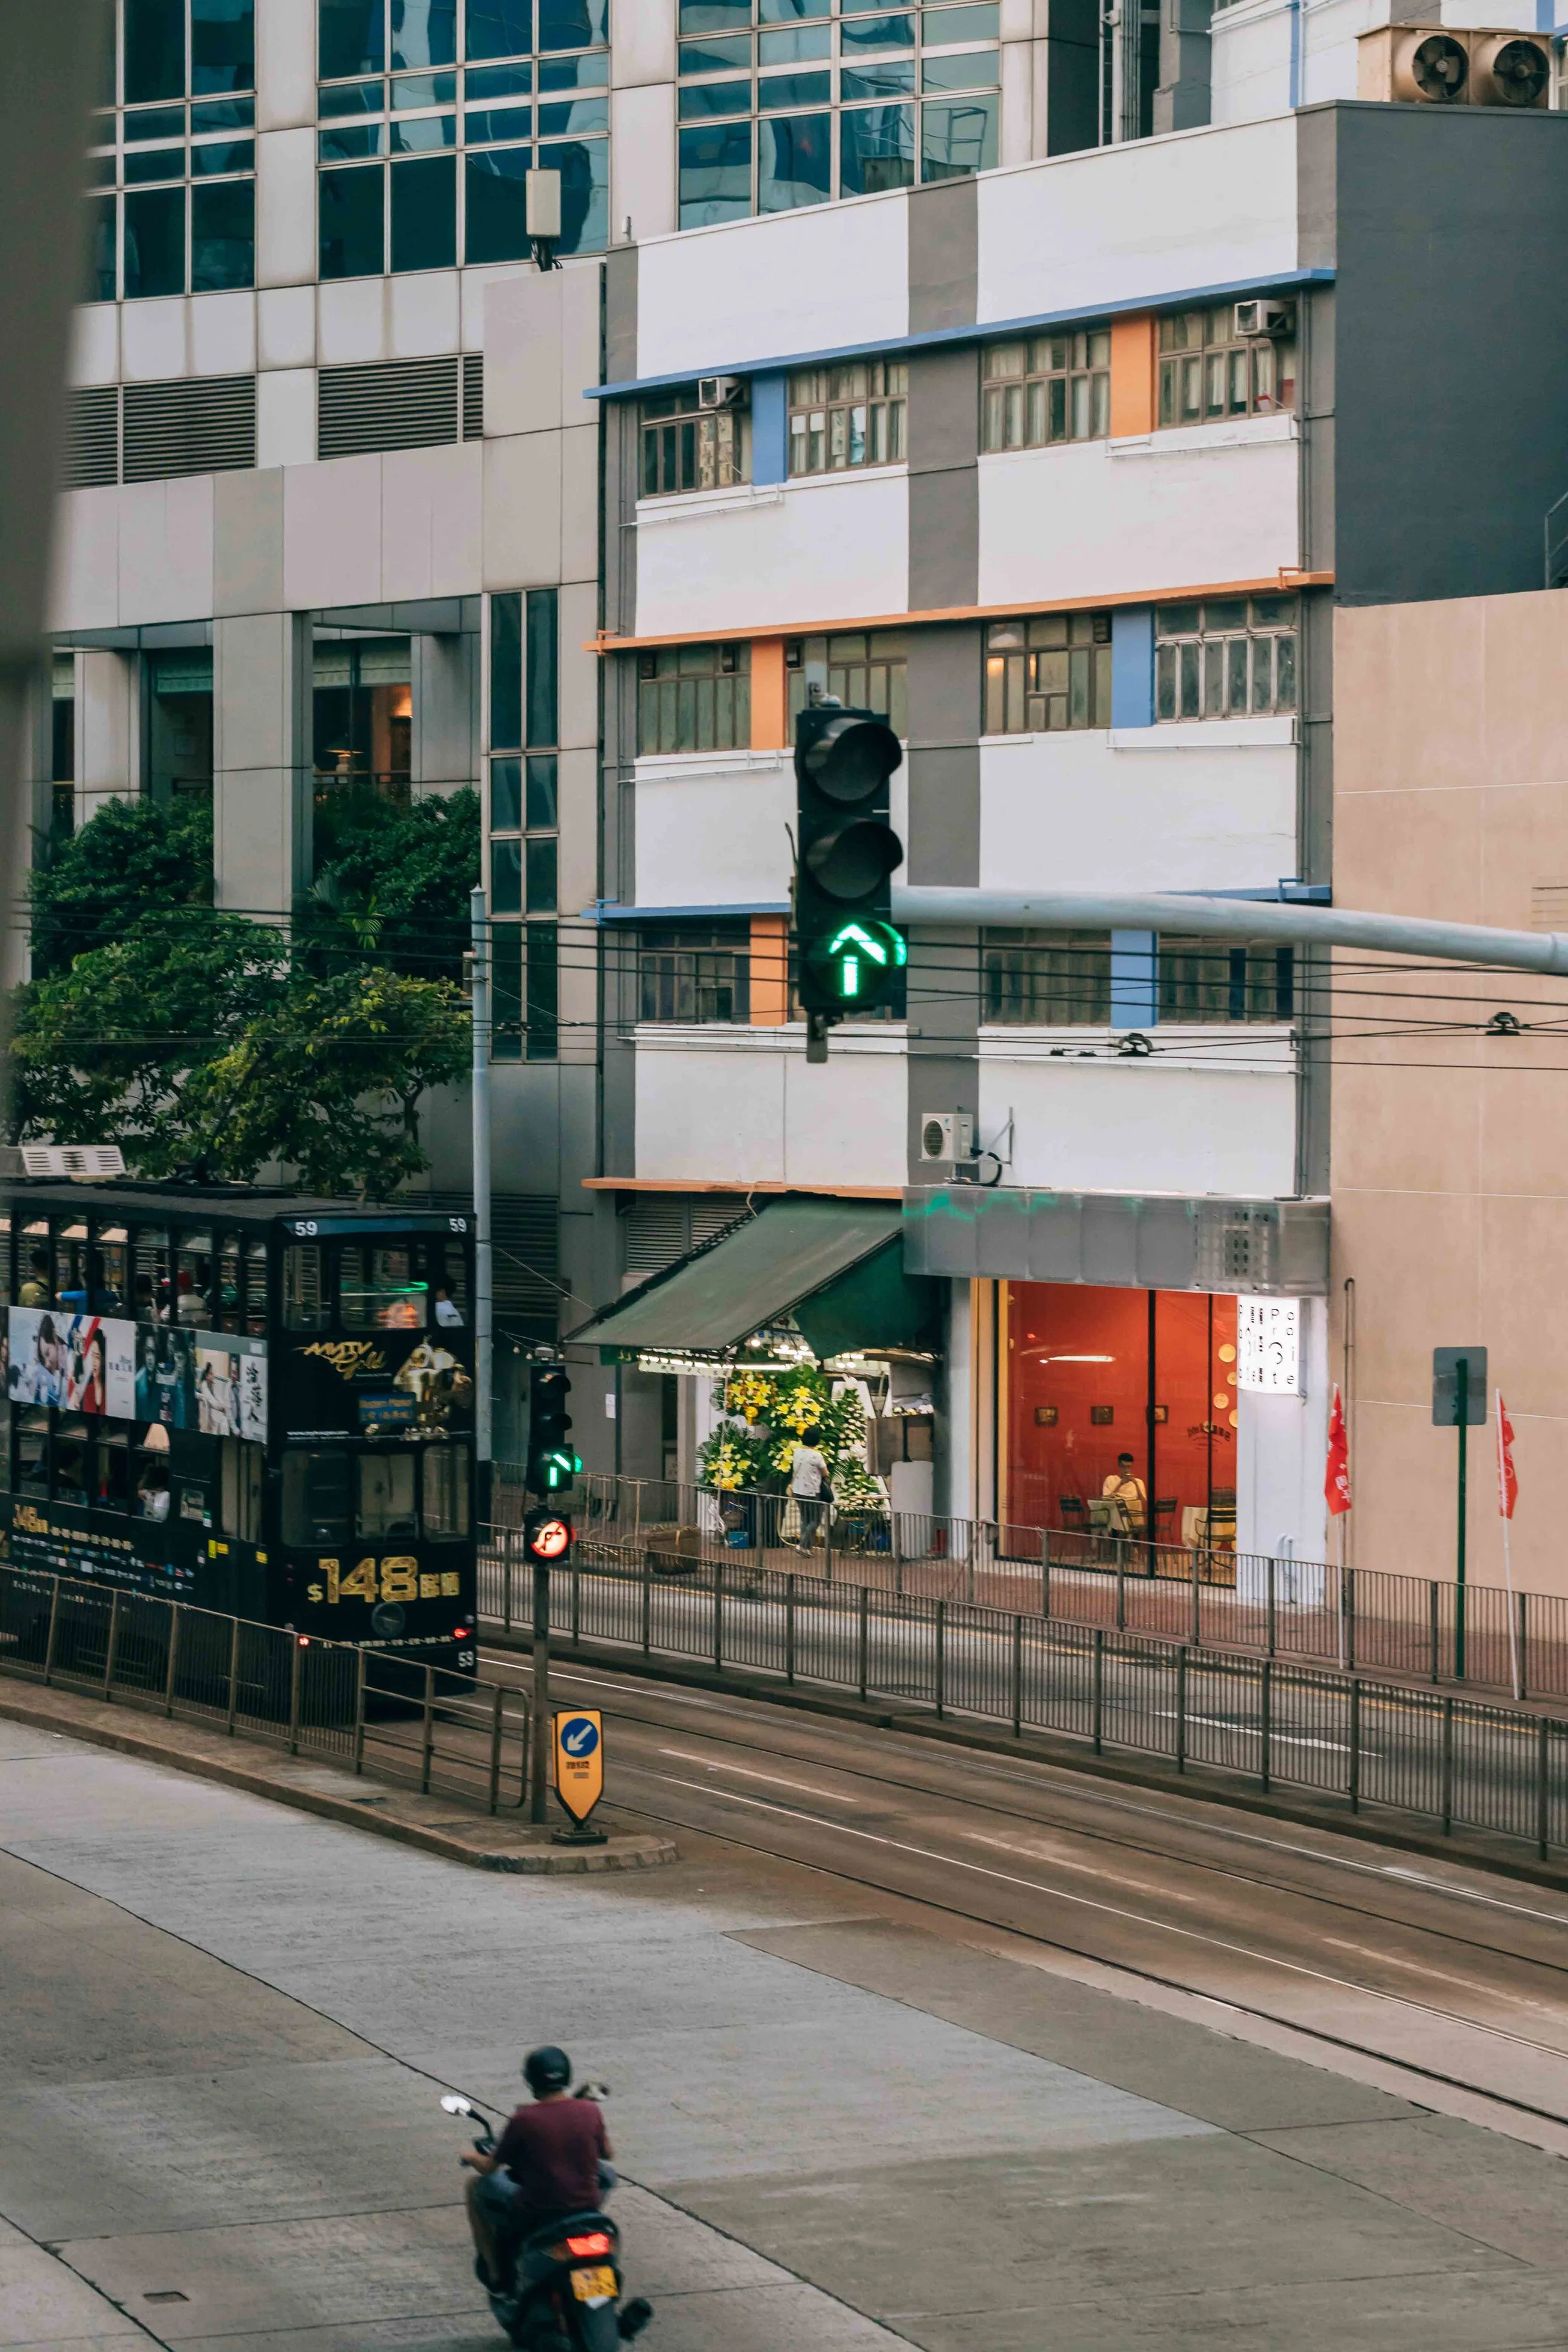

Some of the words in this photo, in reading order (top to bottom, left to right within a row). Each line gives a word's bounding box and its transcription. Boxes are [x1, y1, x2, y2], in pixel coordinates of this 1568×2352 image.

[295, 1221, 318, 1236] 59
[449, 1218, 467, 1233] 59
[307, 1556, 418, 1604] $148
[458, 1651, 474, 1667] 59
